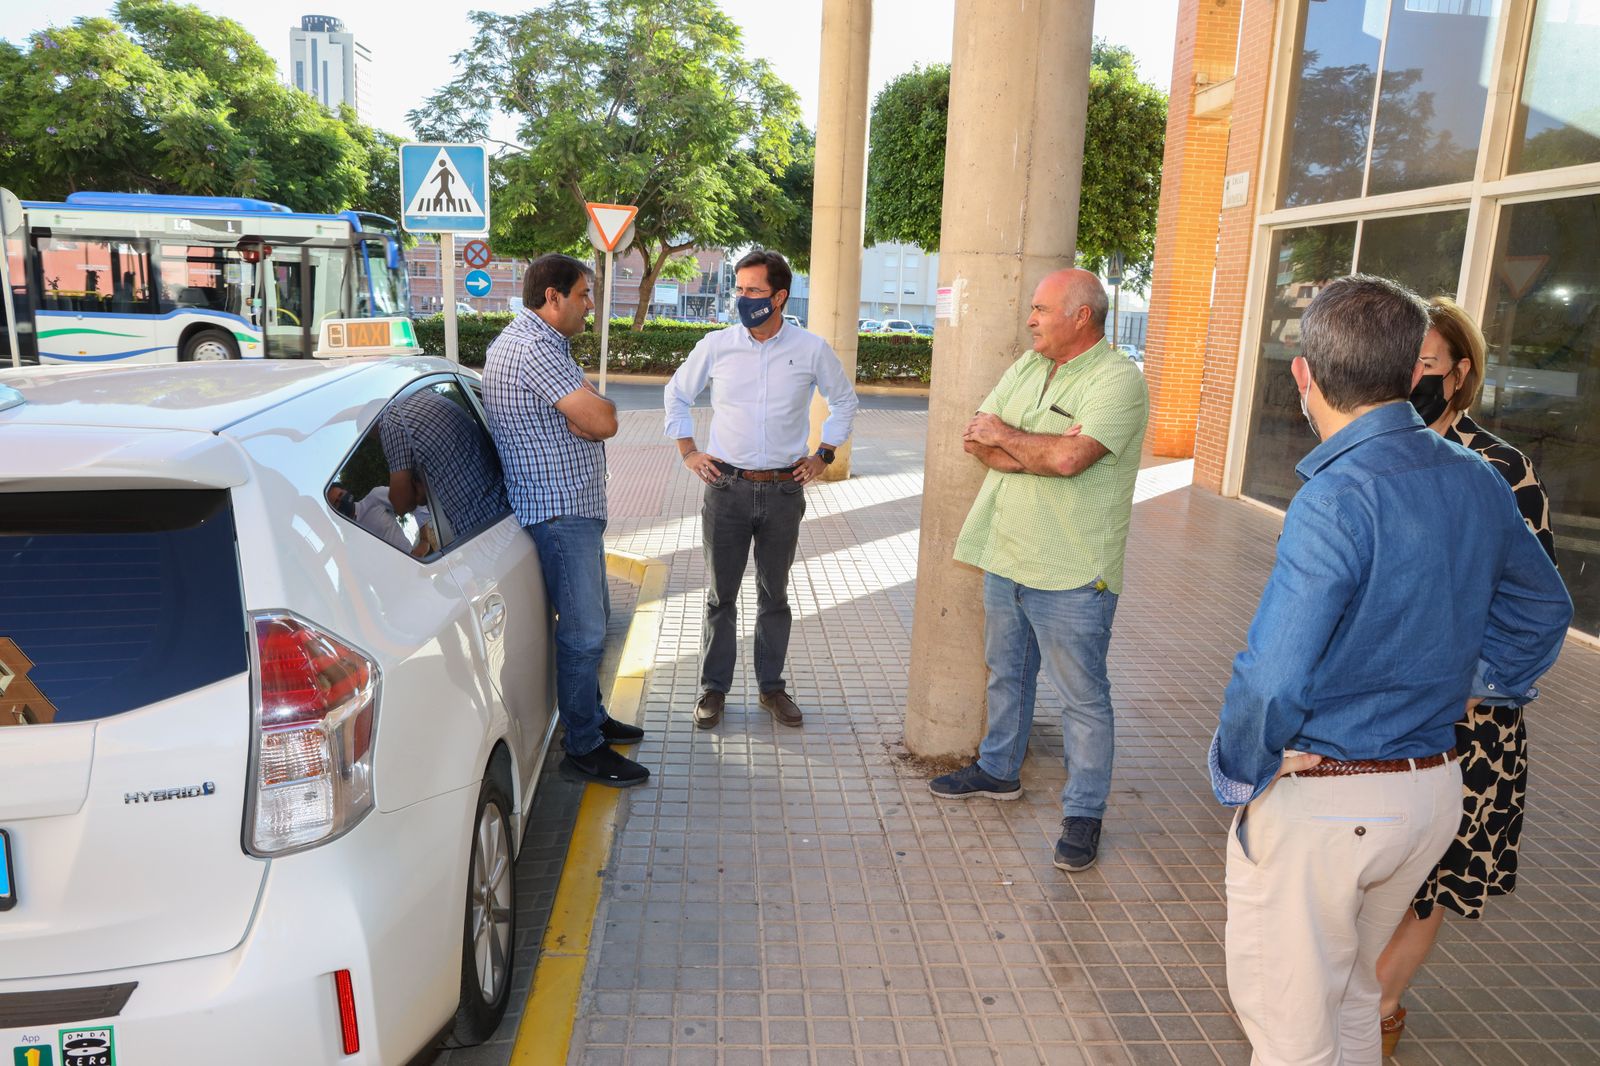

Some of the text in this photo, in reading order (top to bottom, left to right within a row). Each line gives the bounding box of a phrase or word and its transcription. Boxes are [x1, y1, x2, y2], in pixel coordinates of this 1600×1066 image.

[348, 322, 389, 347] TAXI
[124, 785, 201, 804] HYBRID
[21, 1034, 40, 1043] App
[67, 1031, 106, 1040] ONDA
[65, 1056, 107, 1066] CERO
